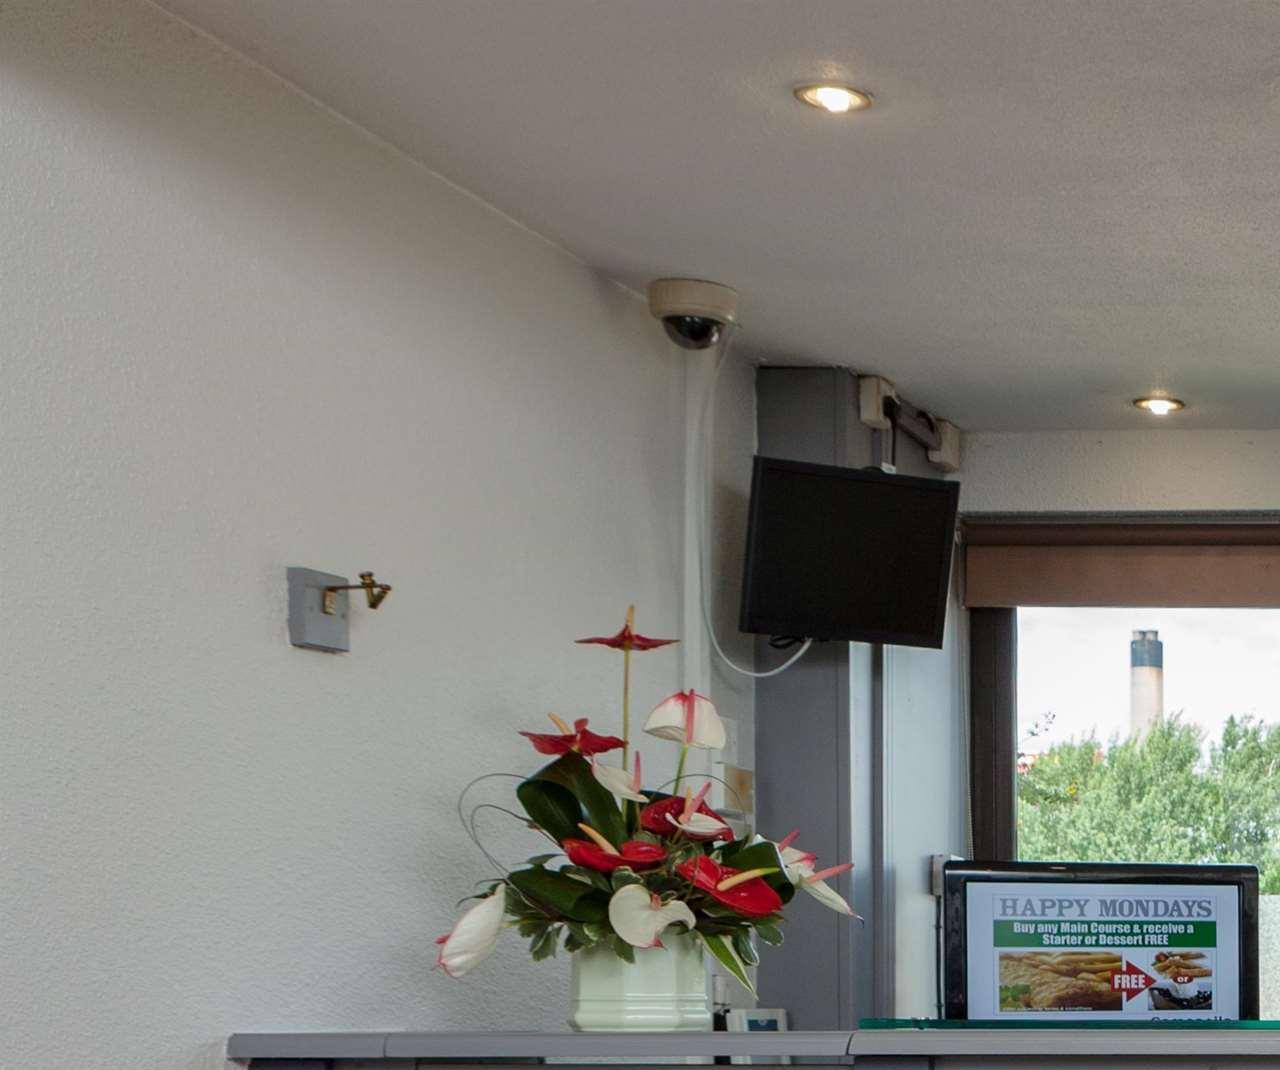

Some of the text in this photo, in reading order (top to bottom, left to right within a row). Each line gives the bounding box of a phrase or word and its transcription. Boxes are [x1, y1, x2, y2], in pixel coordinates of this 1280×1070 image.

[999, 898, 1213, 918] HAPPY MONDAYS
[1013, 922, 1195, 934] Buy any Main Course & receive a
[1042, 934, 1169, 945] Starter or Dessert FREE
[1113, 974, 1147, 989] FREE
